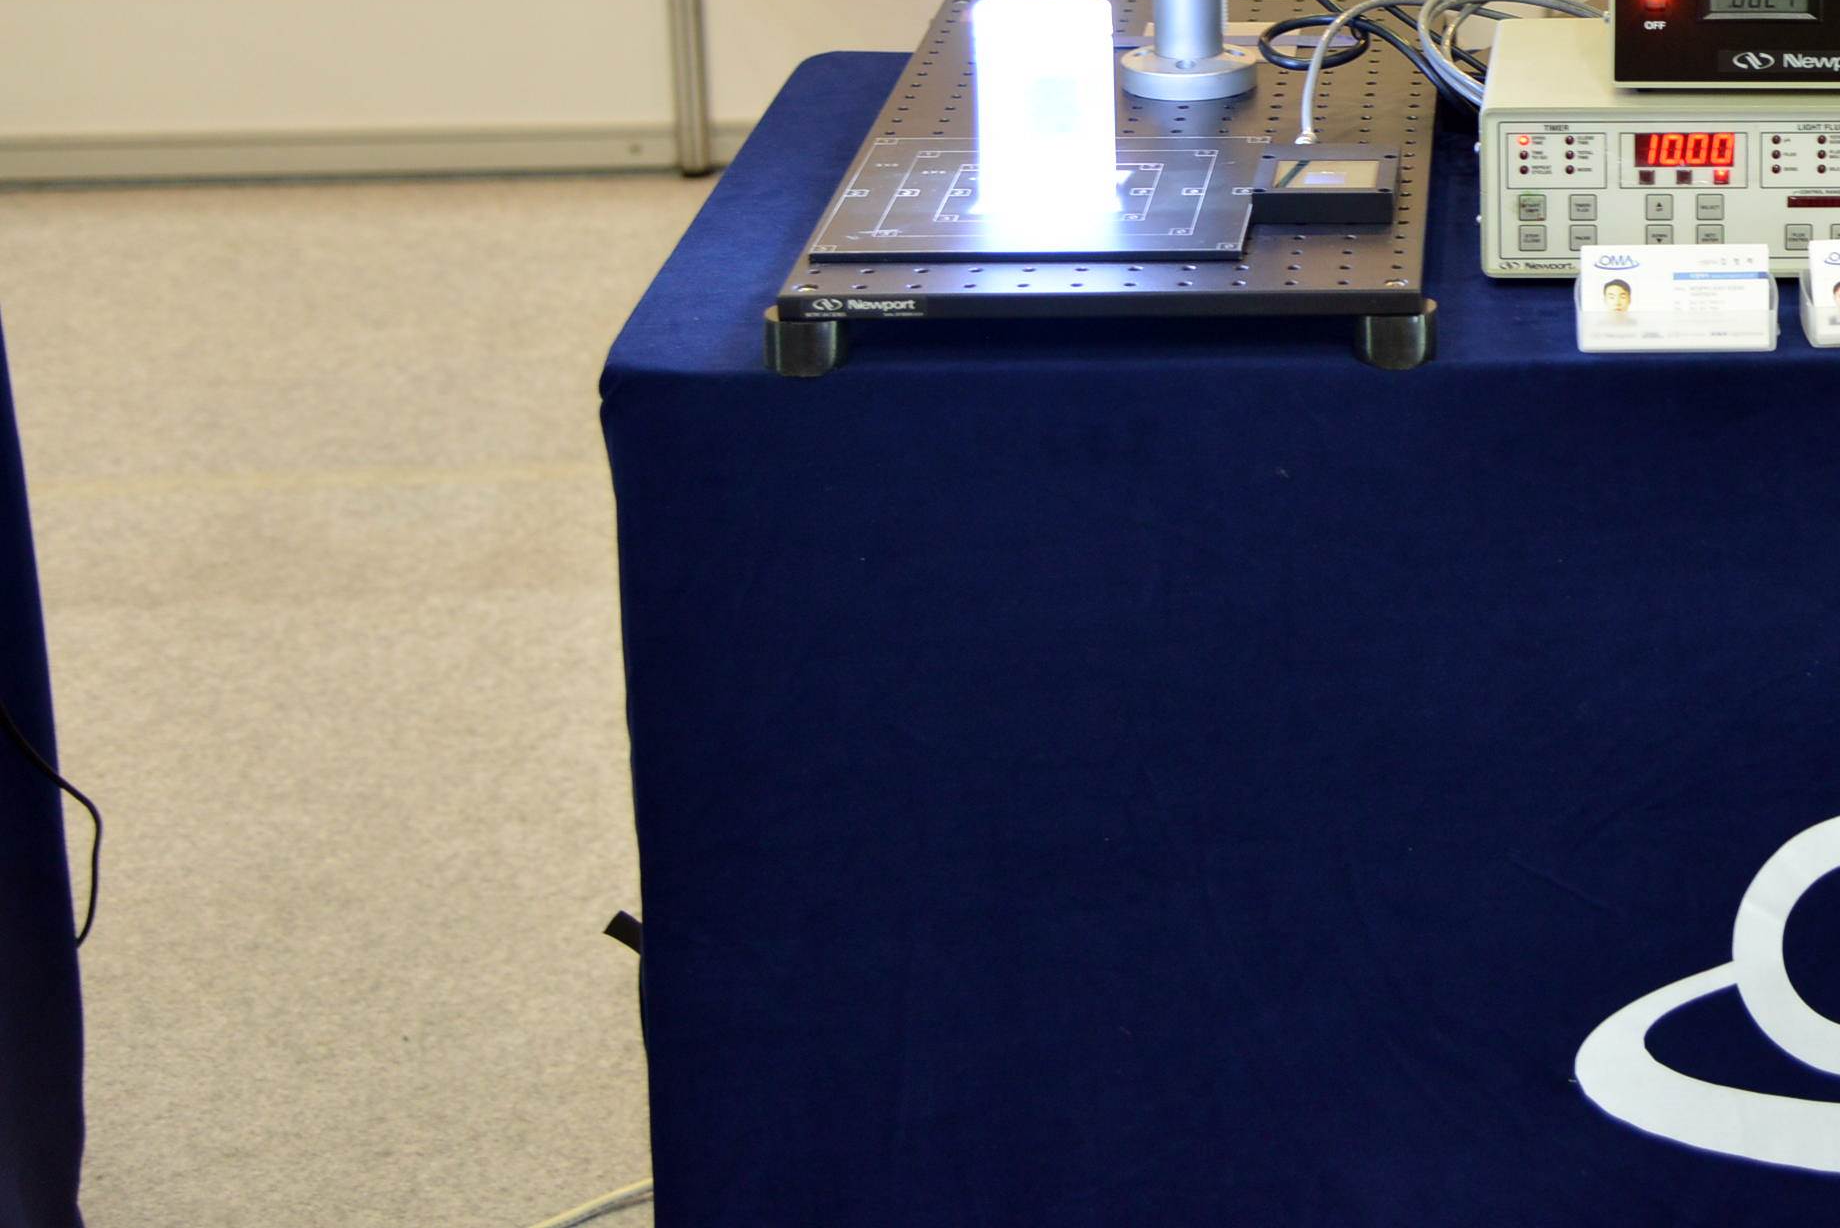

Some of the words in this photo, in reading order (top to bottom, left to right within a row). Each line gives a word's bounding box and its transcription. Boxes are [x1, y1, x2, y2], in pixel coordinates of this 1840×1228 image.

[1644, 21, 1666, 30] OFF
[1544, 124, 1570, 132] TIMER
[1647, 133, 1735, 166] 10.00
[1598, 255, 1635, 268] OMA
[846, 299, 916, 311] Newport
